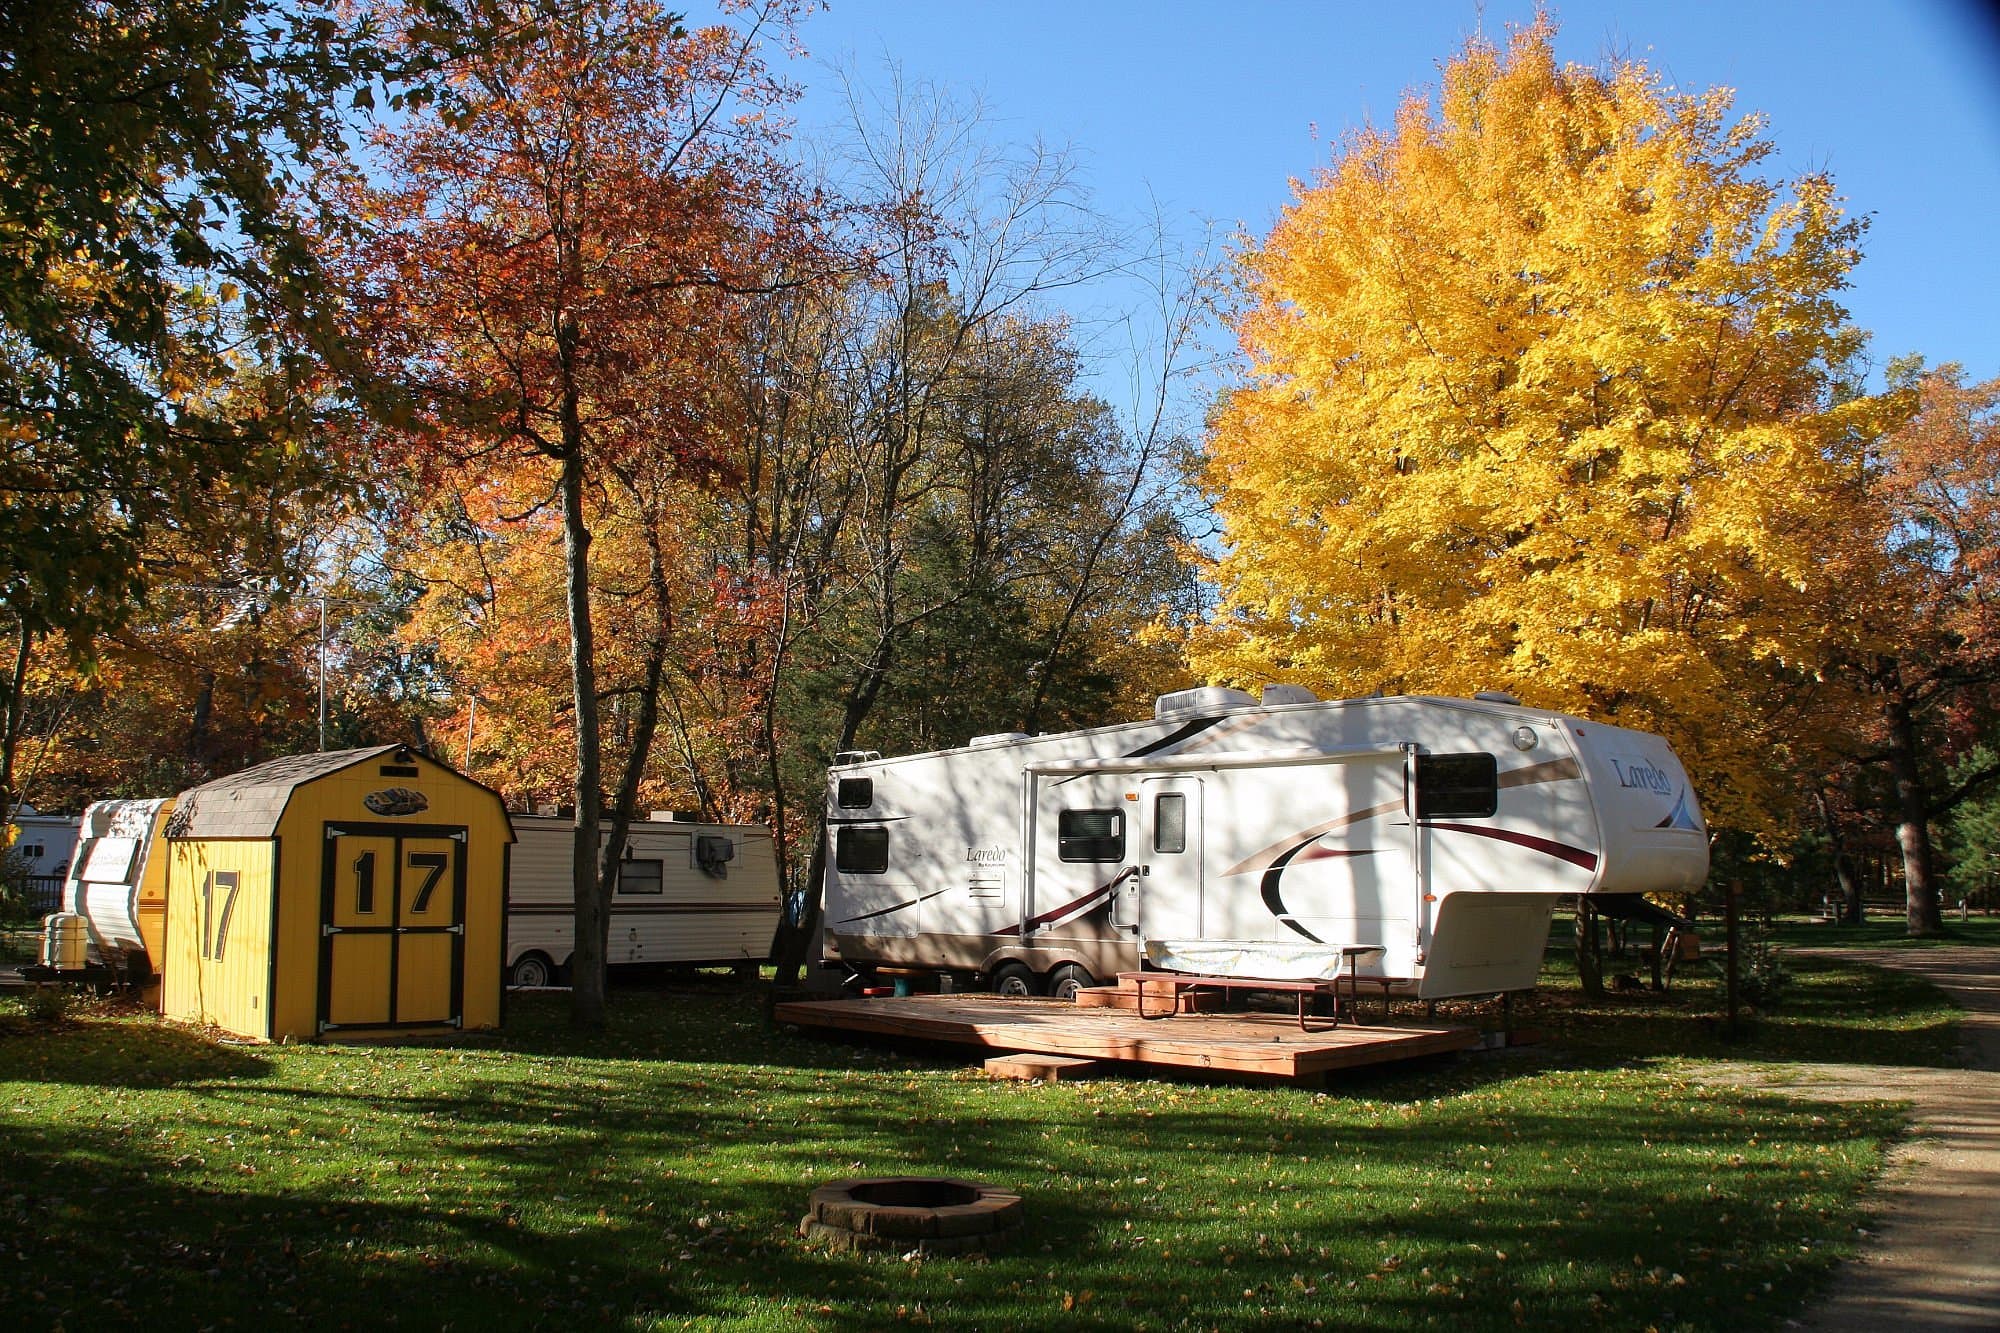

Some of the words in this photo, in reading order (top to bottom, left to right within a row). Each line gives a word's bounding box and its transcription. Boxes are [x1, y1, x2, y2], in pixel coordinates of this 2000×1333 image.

[1610, 758, 1671, 792] Laredo
[966, 845, 1006, 861] Laredo
[202, 869, 240, 963] 17
